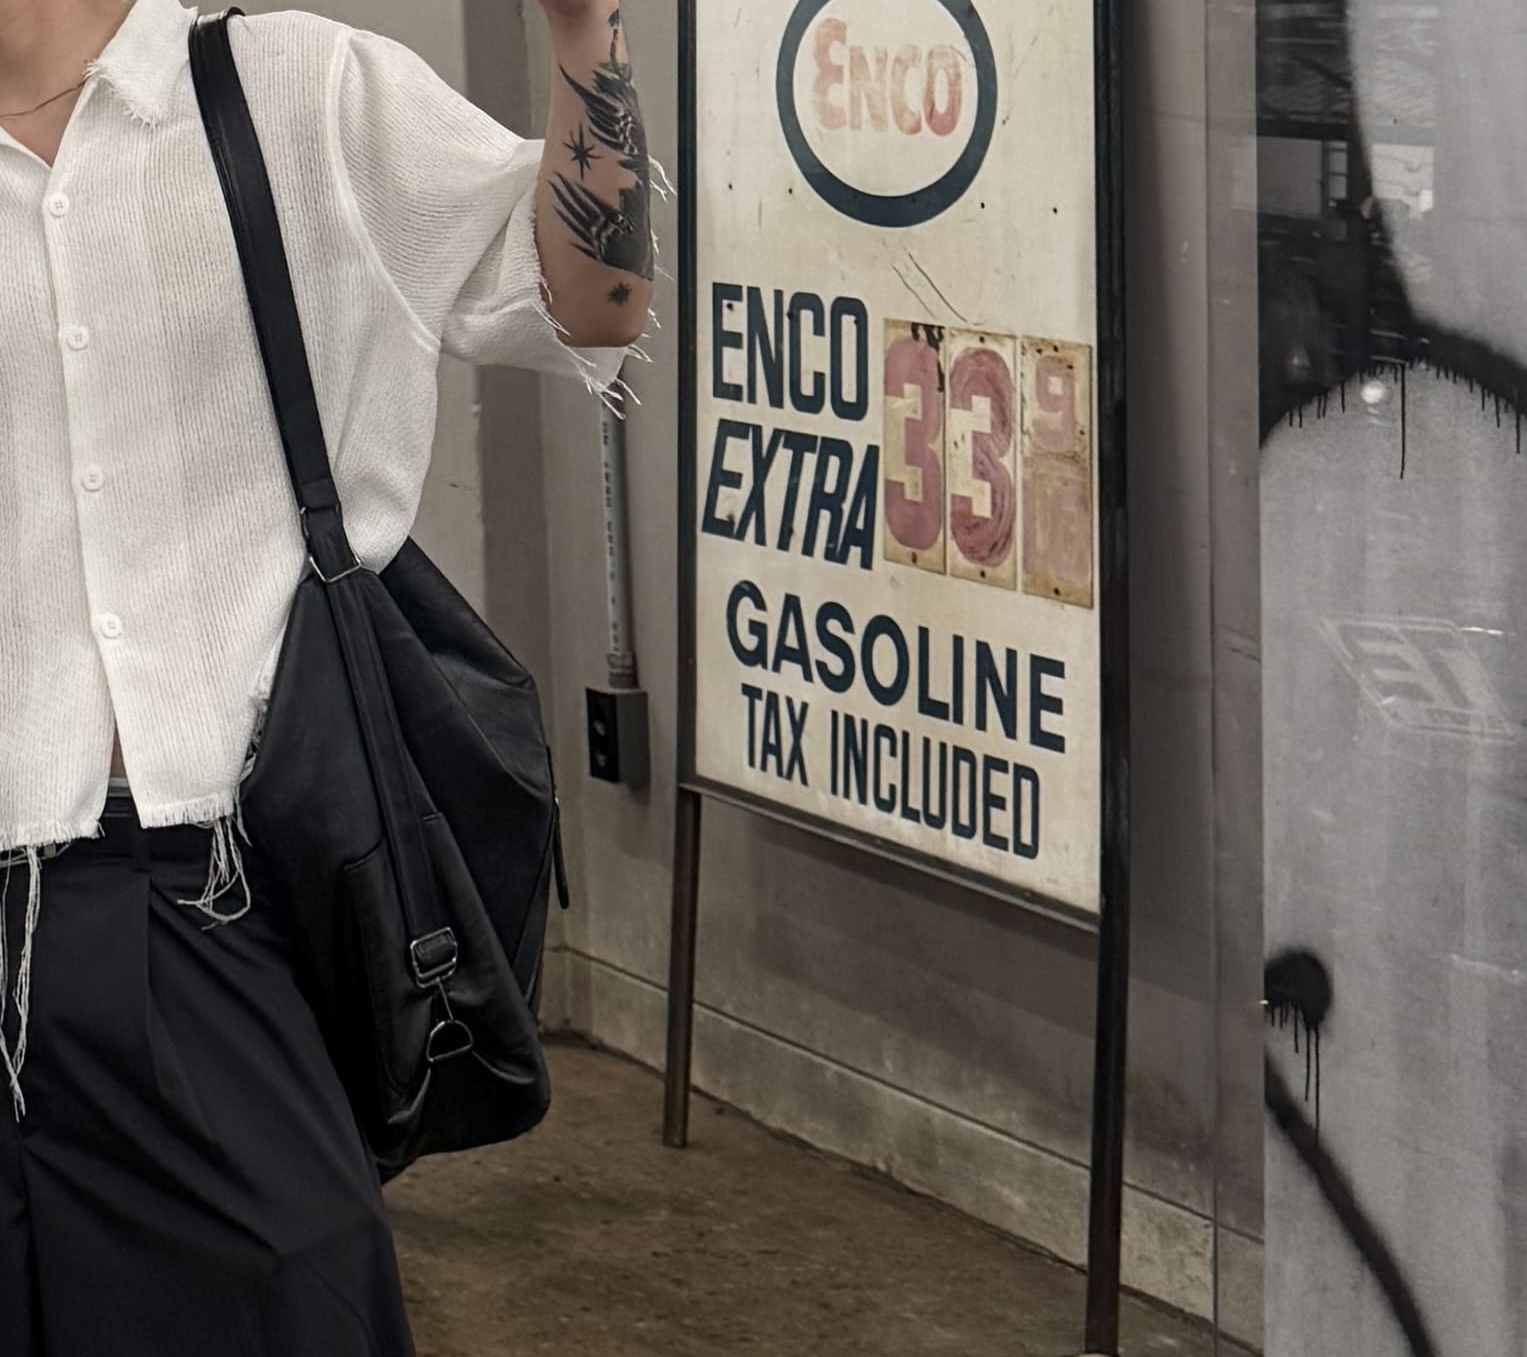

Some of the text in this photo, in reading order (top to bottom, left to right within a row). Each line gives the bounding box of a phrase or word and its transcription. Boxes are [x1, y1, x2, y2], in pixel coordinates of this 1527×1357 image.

[711, 281, 869, 422] ENCO
[701, 418, 880, 572] EXTRA
[725, 579, 1066, 754] GASOLINE
[741, 682, 1041, 861] TAX INCLUDED
